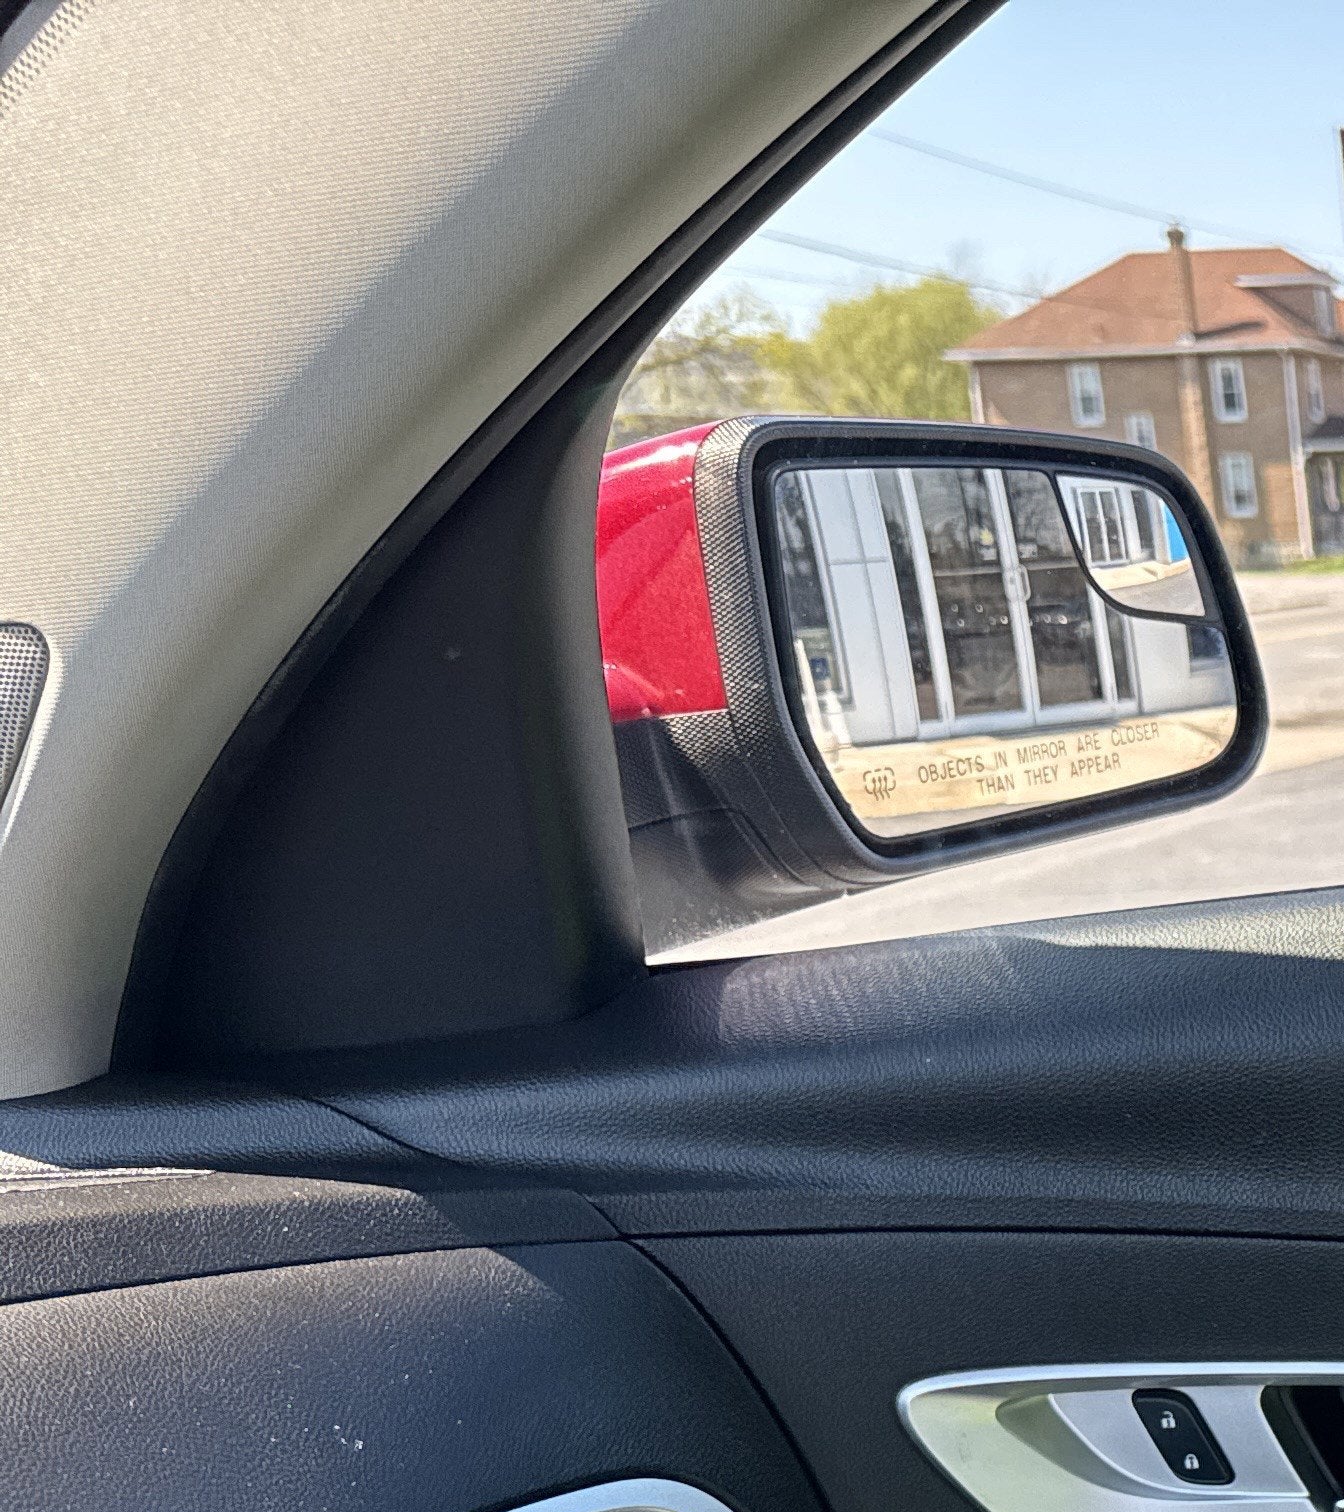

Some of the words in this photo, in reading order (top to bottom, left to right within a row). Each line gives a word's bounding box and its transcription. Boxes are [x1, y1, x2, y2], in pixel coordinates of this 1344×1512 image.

[918, 756, 985, 784] OBJECTS
[994, 751, 1008, 768] IN
[1017, 740, 1067, 764] MIRROR
[1077, 733, 1101, 753] ARE
[1111, 722, 1160, 746] CLOSER
[976, 775, 1015, 796] THAN
[1024, 766, 1058, 785] THEY
[1070, 752, 1121, 778] APPEAR
